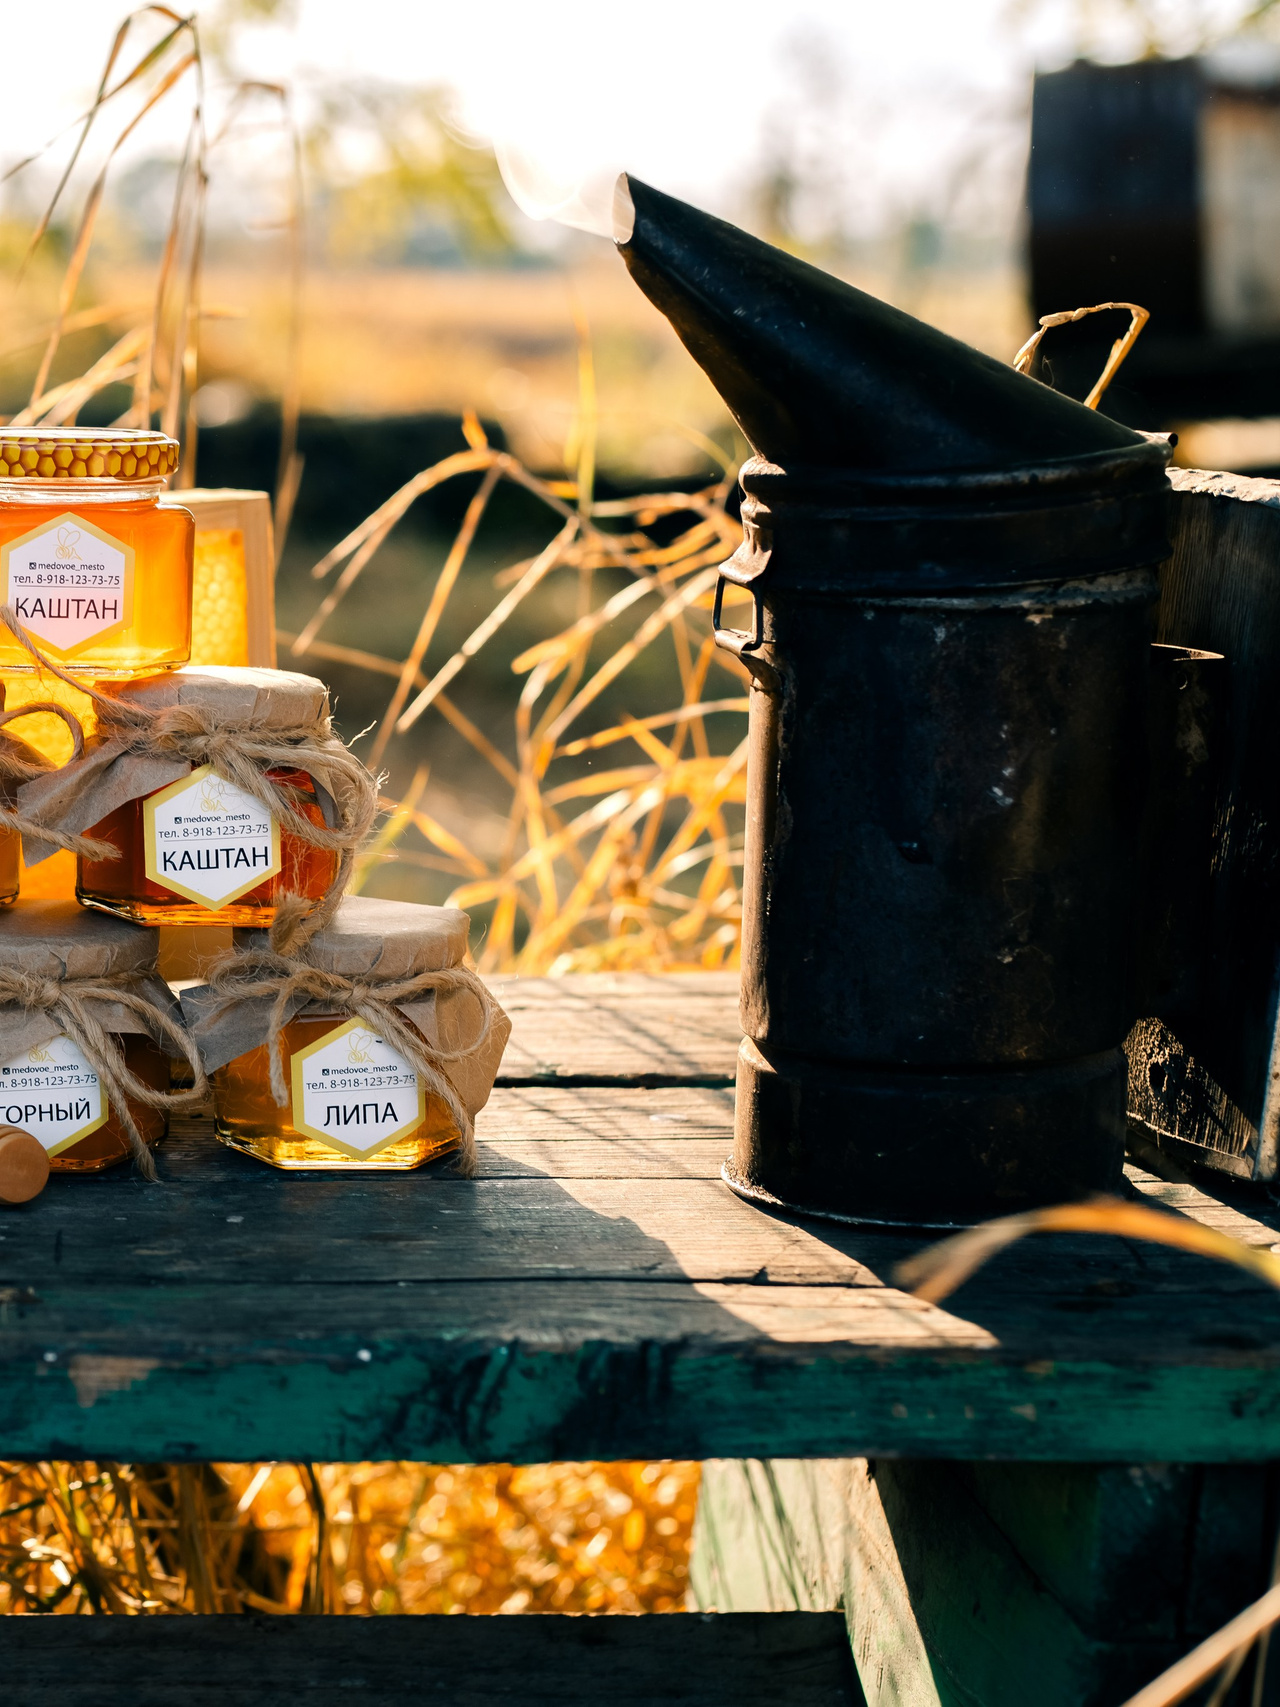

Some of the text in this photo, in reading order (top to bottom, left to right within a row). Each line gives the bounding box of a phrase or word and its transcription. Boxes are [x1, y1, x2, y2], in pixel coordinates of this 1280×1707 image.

[38, 562, 104, 571] medovoe_mesto
[14, 575, 120, 585] тел. 8-918-123-73-75
[15, 598, 117, 619] КАШТАН
[184, 814, 250, 823] medovoe_mesto
[159, 824, 268, 838] тел. 8-918-123-73-75
[163, 846, 268, 871] КАШТАН
[12, 1064, 79, 1074] medovoe_mesto
[331, 1065, 397, 1075] medovoe_mesto
[11, 1074, 97, 1088] 8-918-123-73-75
[330, 1074, 415, 1088] 8-918-123-73-75
[324, 1102, 398, 1126] ЛИПА
